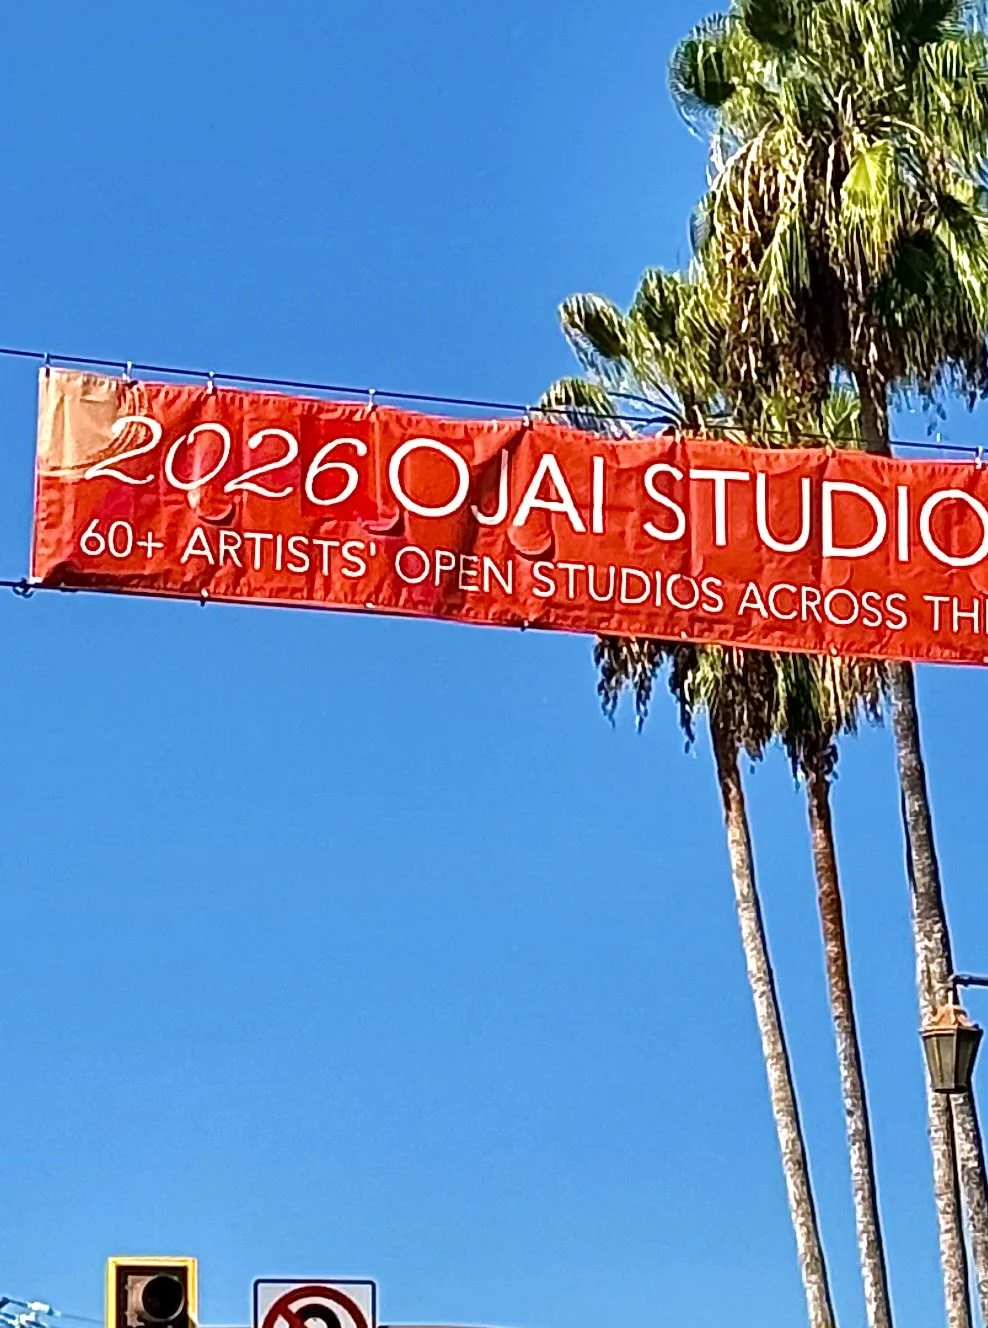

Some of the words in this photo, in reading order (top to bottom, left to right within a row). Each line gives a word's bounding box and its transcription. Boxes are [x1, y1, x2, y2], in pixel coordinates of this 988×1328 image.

[84, 415, 367, 506] 2026
[389, 438, 605, 534] OJAI
[79, 518, 164, 559] 60+
[180, 527, 376, 578] ARTISTS'
[395, 546, 514, 595] OPEN
[532, 560, 724, 614] STUDIOS
[737, 581, 907, 632] ACROSS
